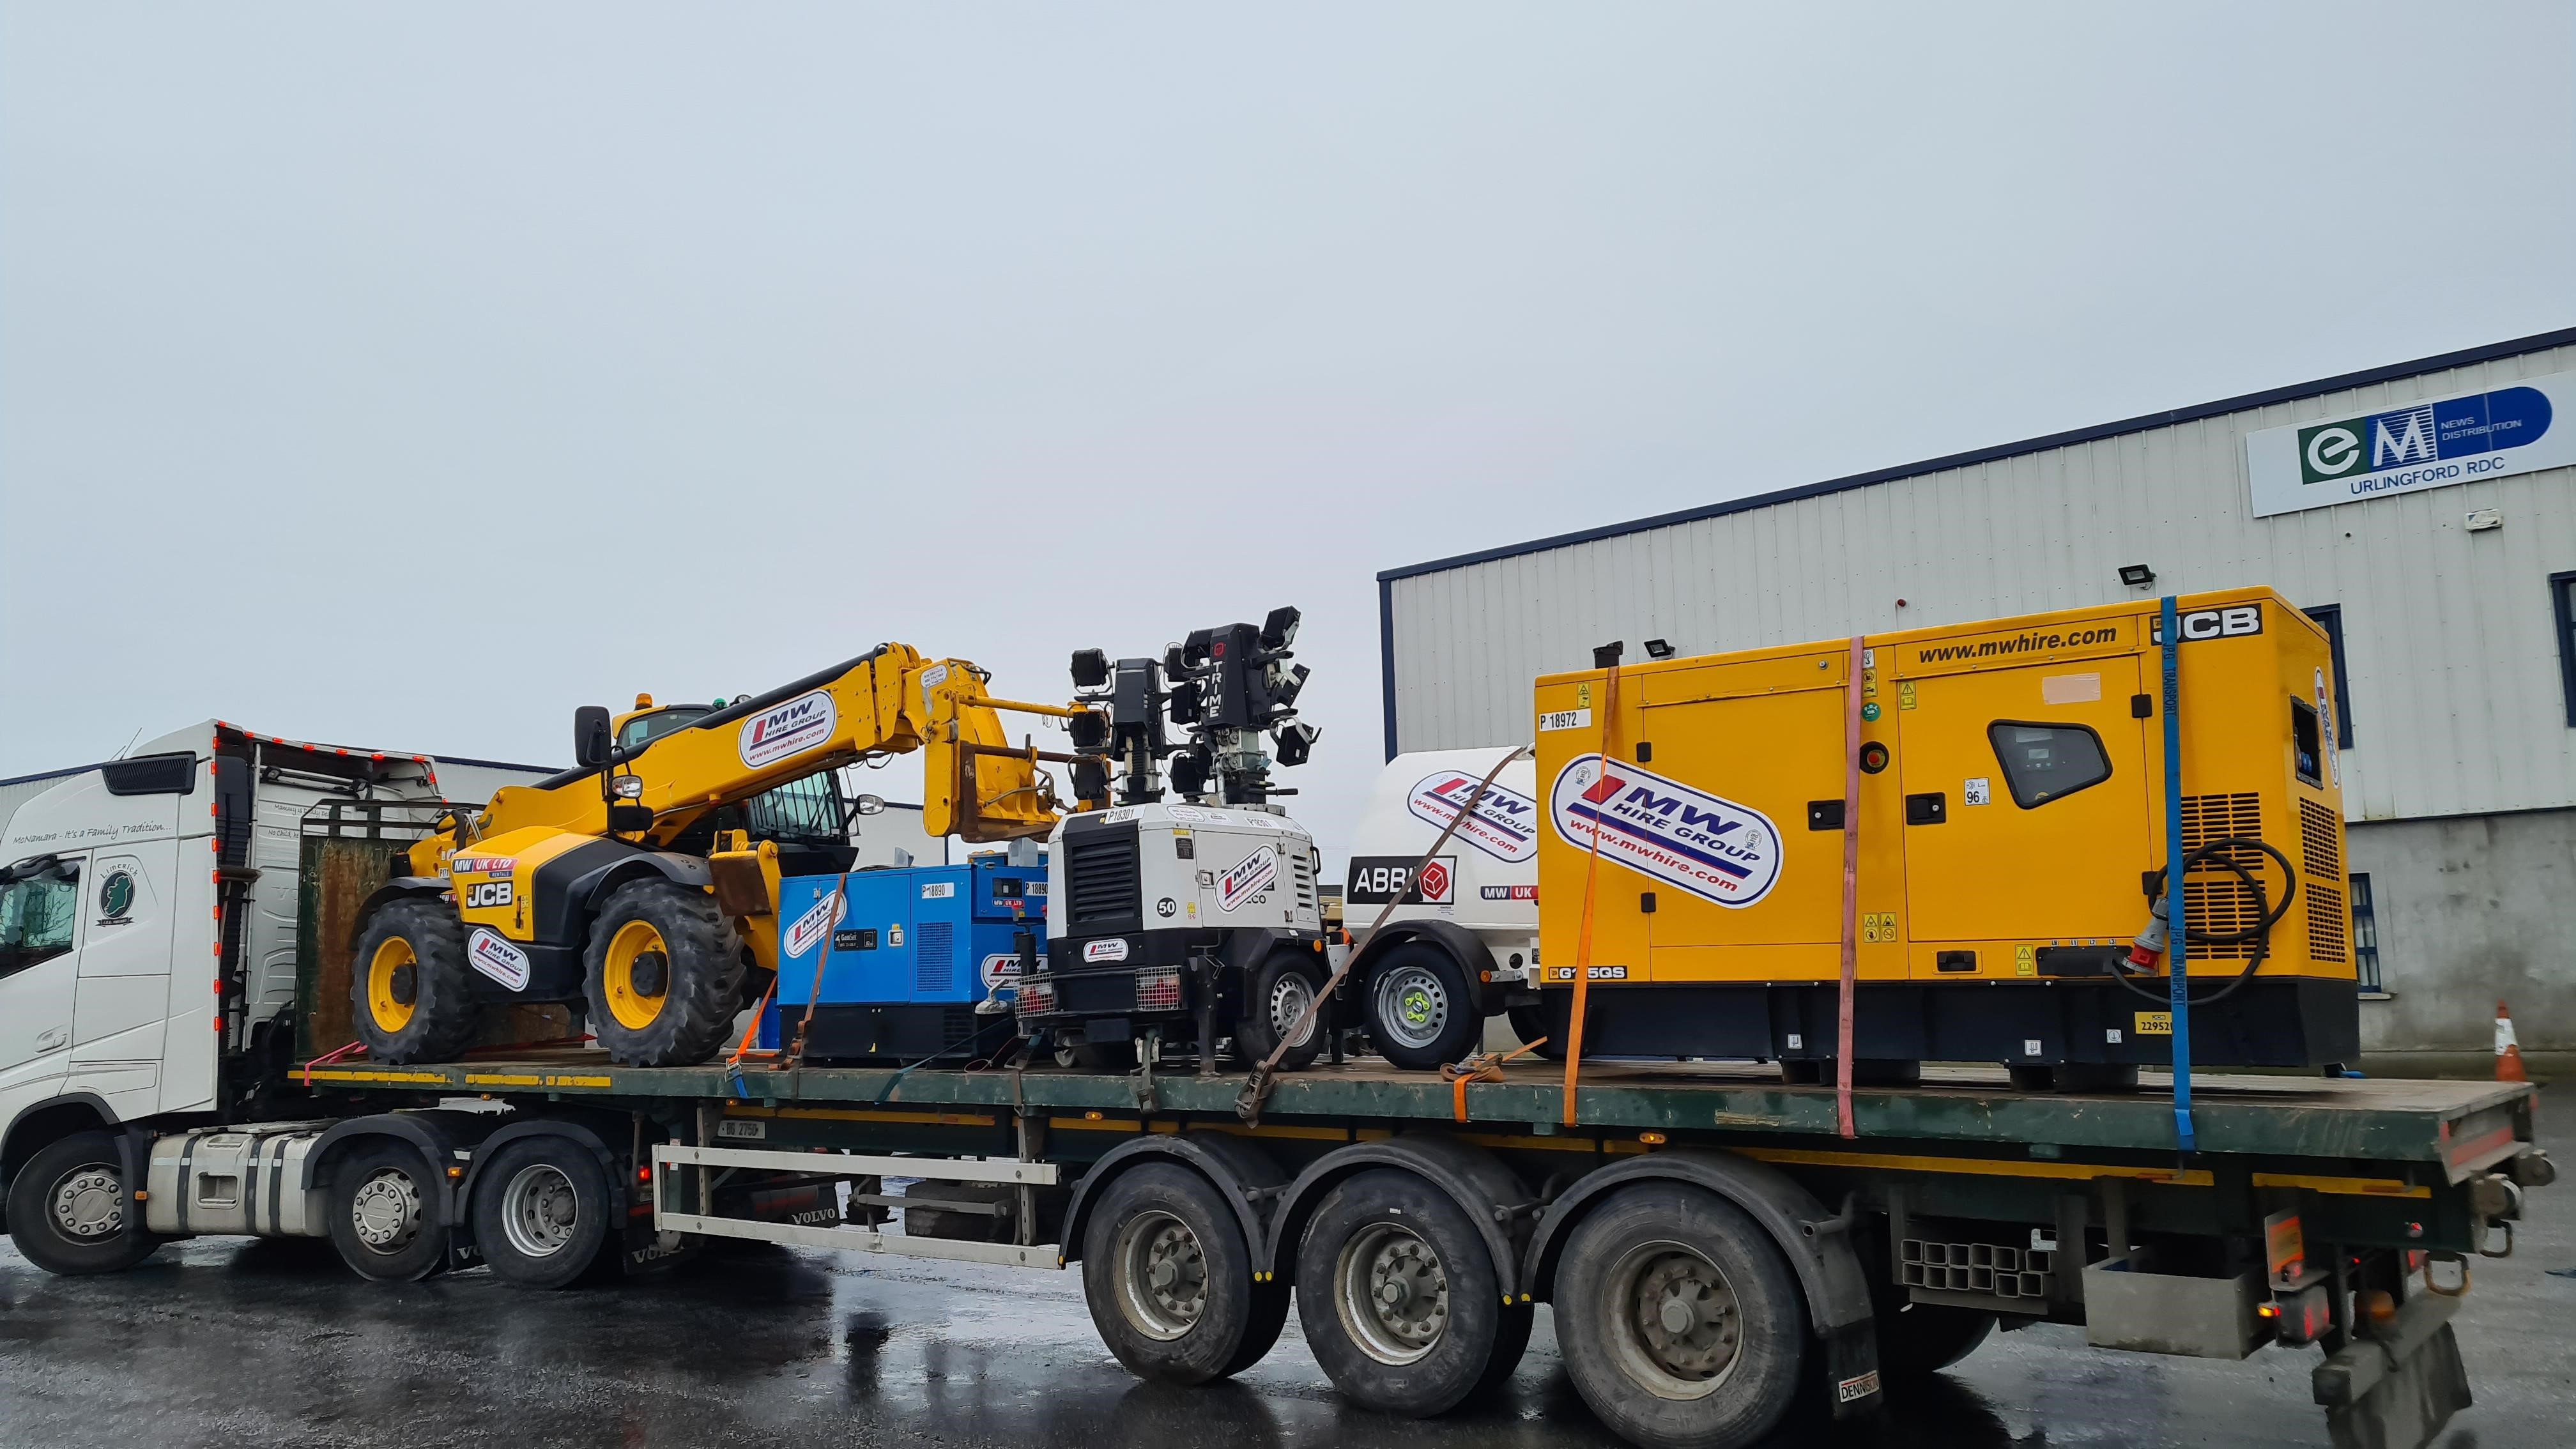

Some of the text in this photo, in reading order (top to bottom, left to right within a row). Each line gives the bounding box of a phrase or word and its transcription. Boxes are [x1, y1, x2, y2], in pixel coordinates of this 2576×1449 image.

[2441, 417, 2475, 430] NEWS
[2442, 419, 2522, 441] DISTRIBUTION
[2350, 457, 2505, 494] URLINGFORD RDC
[1919, 627, 2117, 663] www.mwhire.com
[1209, 661, 1223, 717] TRIME
[2163, 642, 2177, 716] JPG TRANSPORT
[765, 710, 827, 738] HIRE GROUP
[767, 700, 814, 728] MW
[1540, 712, 1577, 729] P 18972
[749, 728, 825, 761] www.mwhire.com
[1461, 784, 1533, 815] MW
[1624, 786, 1743, 835] MW
[1967, 791, 1979, 803] 96
[1108, 808, 1134, 822] P18301
[1413, 798, 1518, 853] www.mhire.com
[1448, 793, 1536, 834] HIE GROUP
[65, 829, 77, 839] It's
[87, 824, 119, 840] Family
[1612, 803, 1671, 830] HIRE
[1675, 827, 1761, 862] GROUP
[454, 859, 512, 871] MW UK LTD
[1234, 854, 1261, 882] MW
[1570, 820, 1738, 892] www.mwhire.com
[1233, 857, 1271, 889] HIRE GROUP
[467, 883, 512, 907] JCB
[1227, 869, 1273, 907] www.mwhire.com
[1485, 887, 1532, 898] MW UK
[803, 900, 830, 928] MW
[1158, 901, 1176, 914] 50
[802, 921, 816, 936] HIRE
[486, 950, 523, 972] HIRE GROUP
[489, 942, 519, 961] MW
[473, 956, 518, 983] www.mwhire.com
[2171, 925, 2186, 1007] JPG TRANSPORT
[792, 1208, 835, 1225] VOLVO
